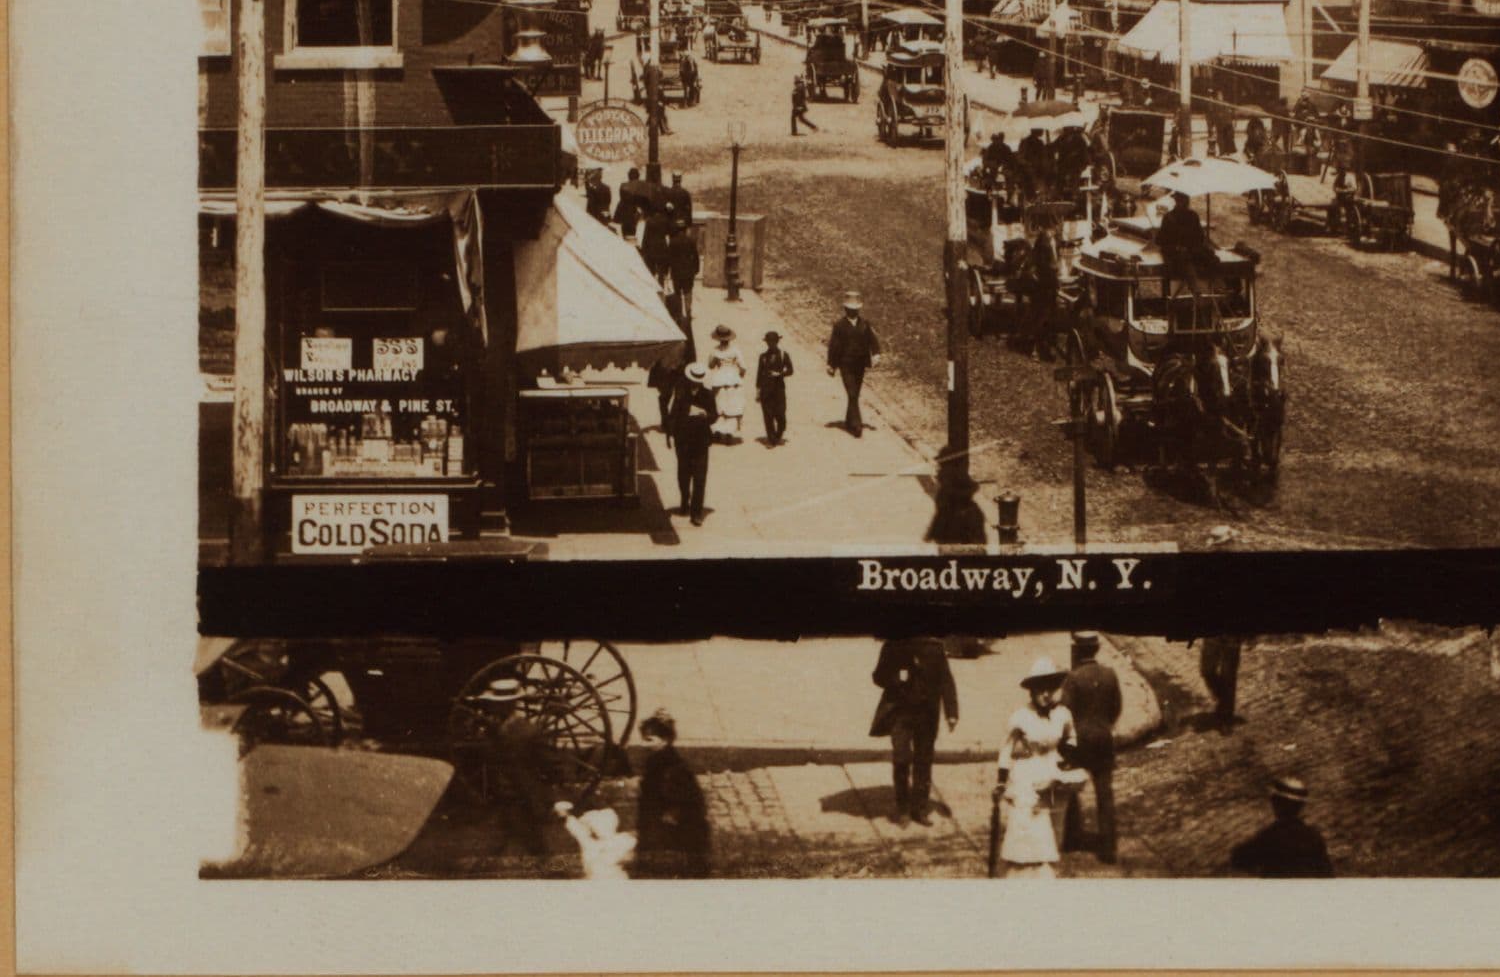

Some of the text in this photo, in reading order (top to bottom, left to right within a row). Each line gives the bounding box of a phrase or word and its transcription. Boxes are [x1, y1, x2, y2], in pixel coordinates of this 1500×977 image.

[284, 369, 419, 382] WILSON'S PHARMACY
[310, 399, 377, 413] BROADWAY
[381, 399, 392, 413] &
[399, 399, 430, 413] PINE
[303, 501, 437, 516] PERFECTION
